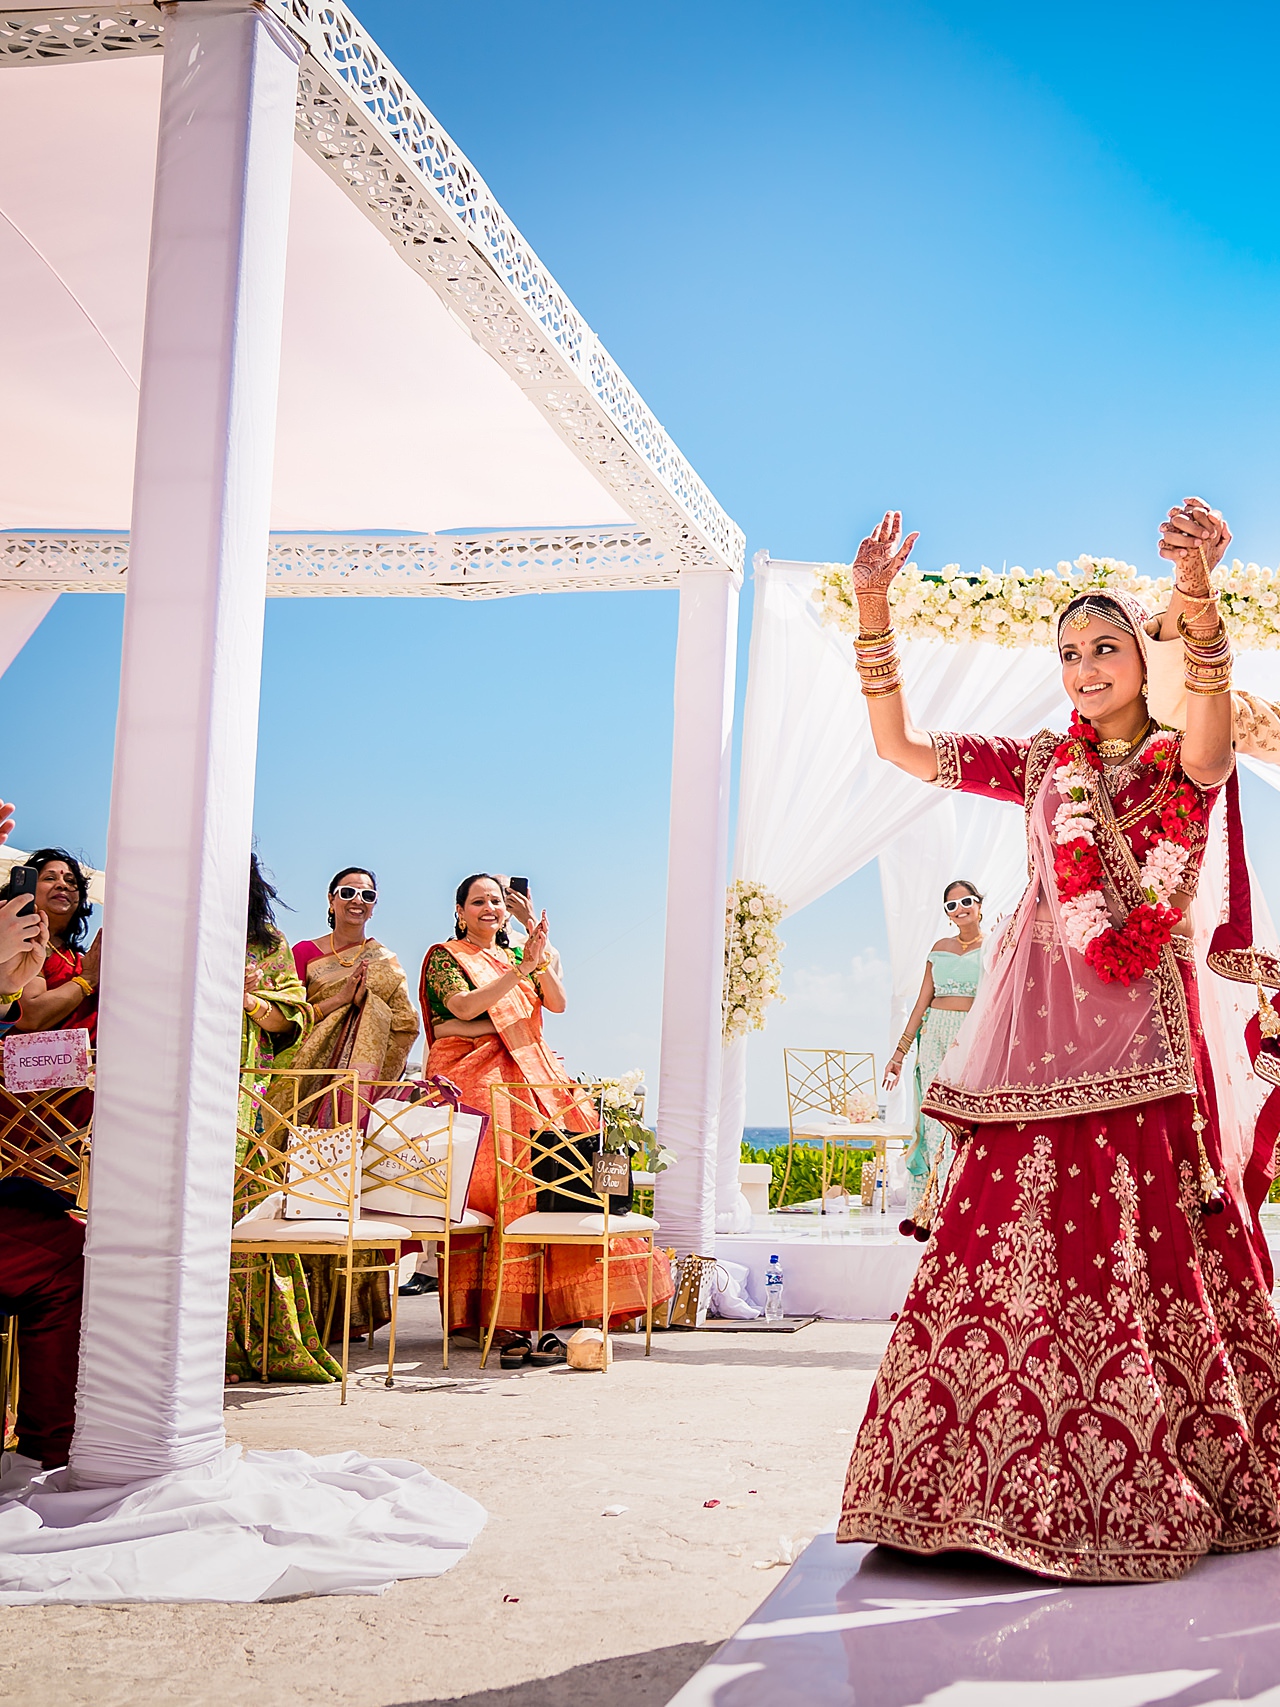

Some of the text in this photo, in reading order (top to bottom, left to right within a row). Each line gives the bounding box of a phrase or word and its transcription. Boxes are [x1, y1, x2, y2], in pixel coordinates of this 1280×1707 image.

[19, 1053, 73, 1068] RESERVED
[596, 1160, 628, 1176] Reserved
[602, 1174, 620, 1188] Row
